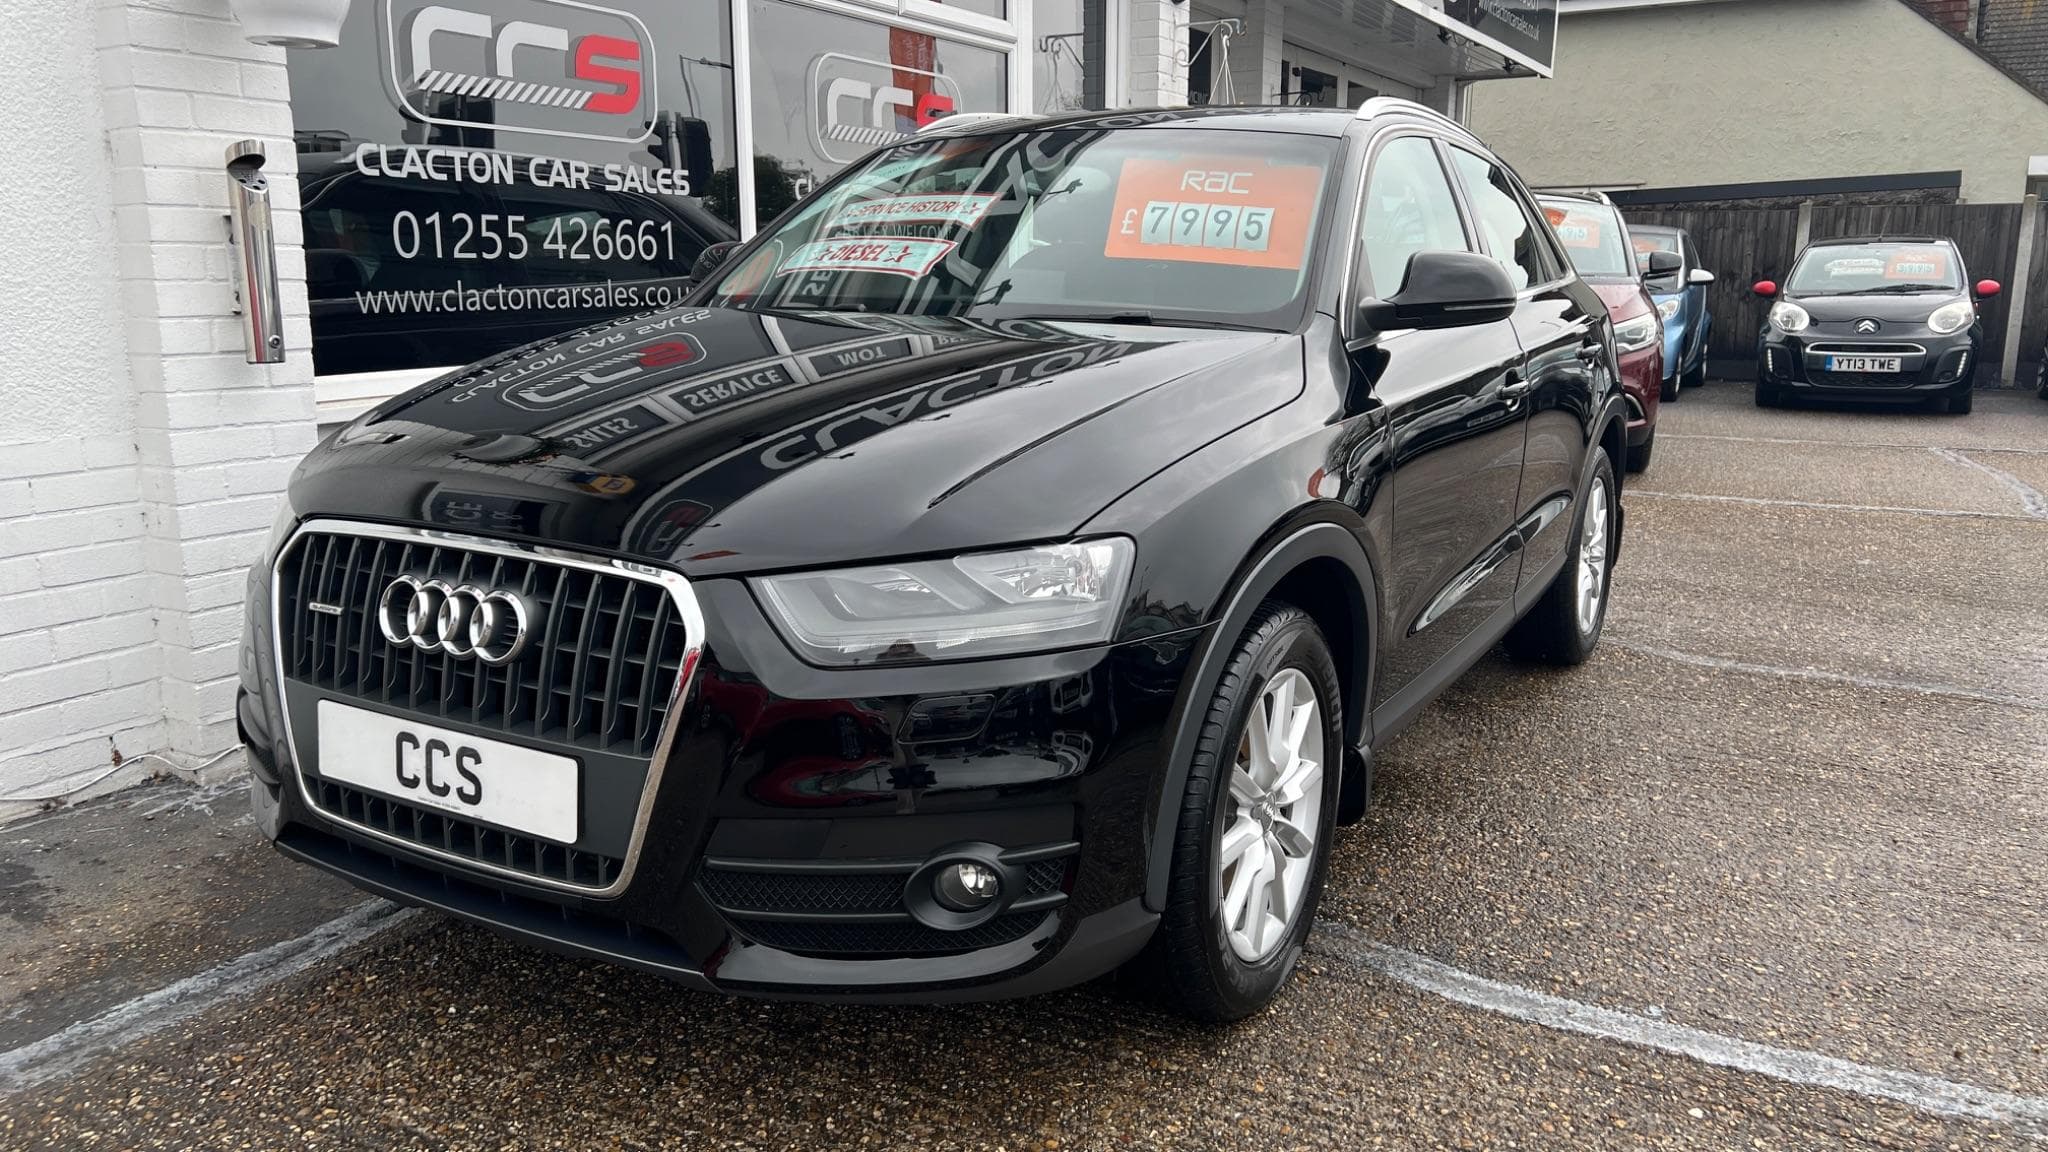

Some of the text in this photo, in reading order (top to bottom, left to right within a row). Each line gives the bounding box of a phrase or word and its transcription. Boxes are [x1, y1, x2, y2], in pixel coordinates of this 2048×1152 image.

[411, 6, 640, 114] CCS
[356, 143, 690, 195] CLACTON CAR SALES
[907, 200, 961, 214] HISTORY
[1120, 206, 1267, 242] £ 7995
[393, 210, 528, 260] 01255
[543, 216, 674, 261] 426661
[831, 244, 891, 262] DIESEL
[1837, 358, 1896, 371] YT13 TWE
[396, 731, 482, 806] CCS
